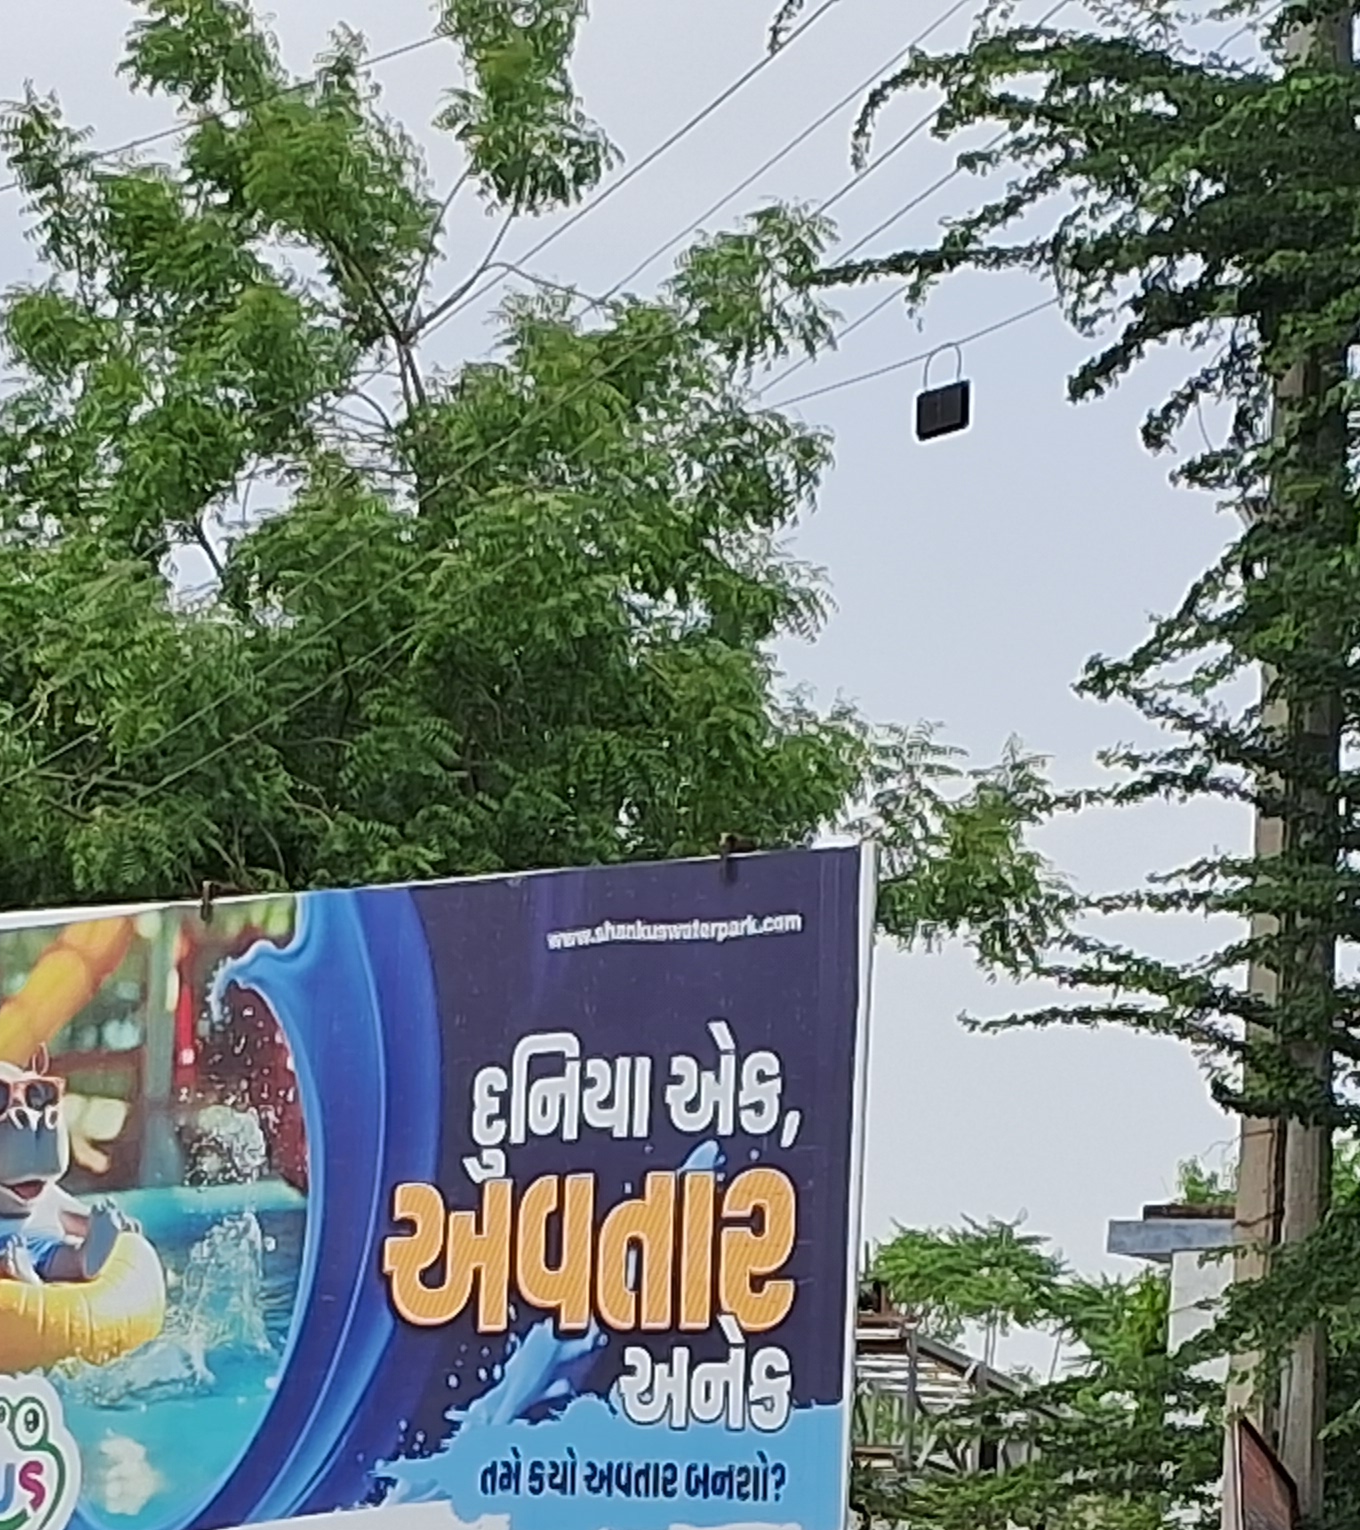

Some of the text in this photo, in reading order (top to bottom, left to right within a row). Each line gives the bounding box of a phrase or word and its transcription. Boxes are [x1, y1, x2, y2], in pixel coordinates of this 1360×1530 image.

[546, 913, 803, 950] www.shankuswaterpark.com
[462, 1019, 802, 1184] દુનિયા એક,
[382, 1165, 797, 1332] અવતાર
[618, 1313, 792, 1431] અનેક
[480, 1447, 787, 1502] તમે કયો અવતાર બનશો?
